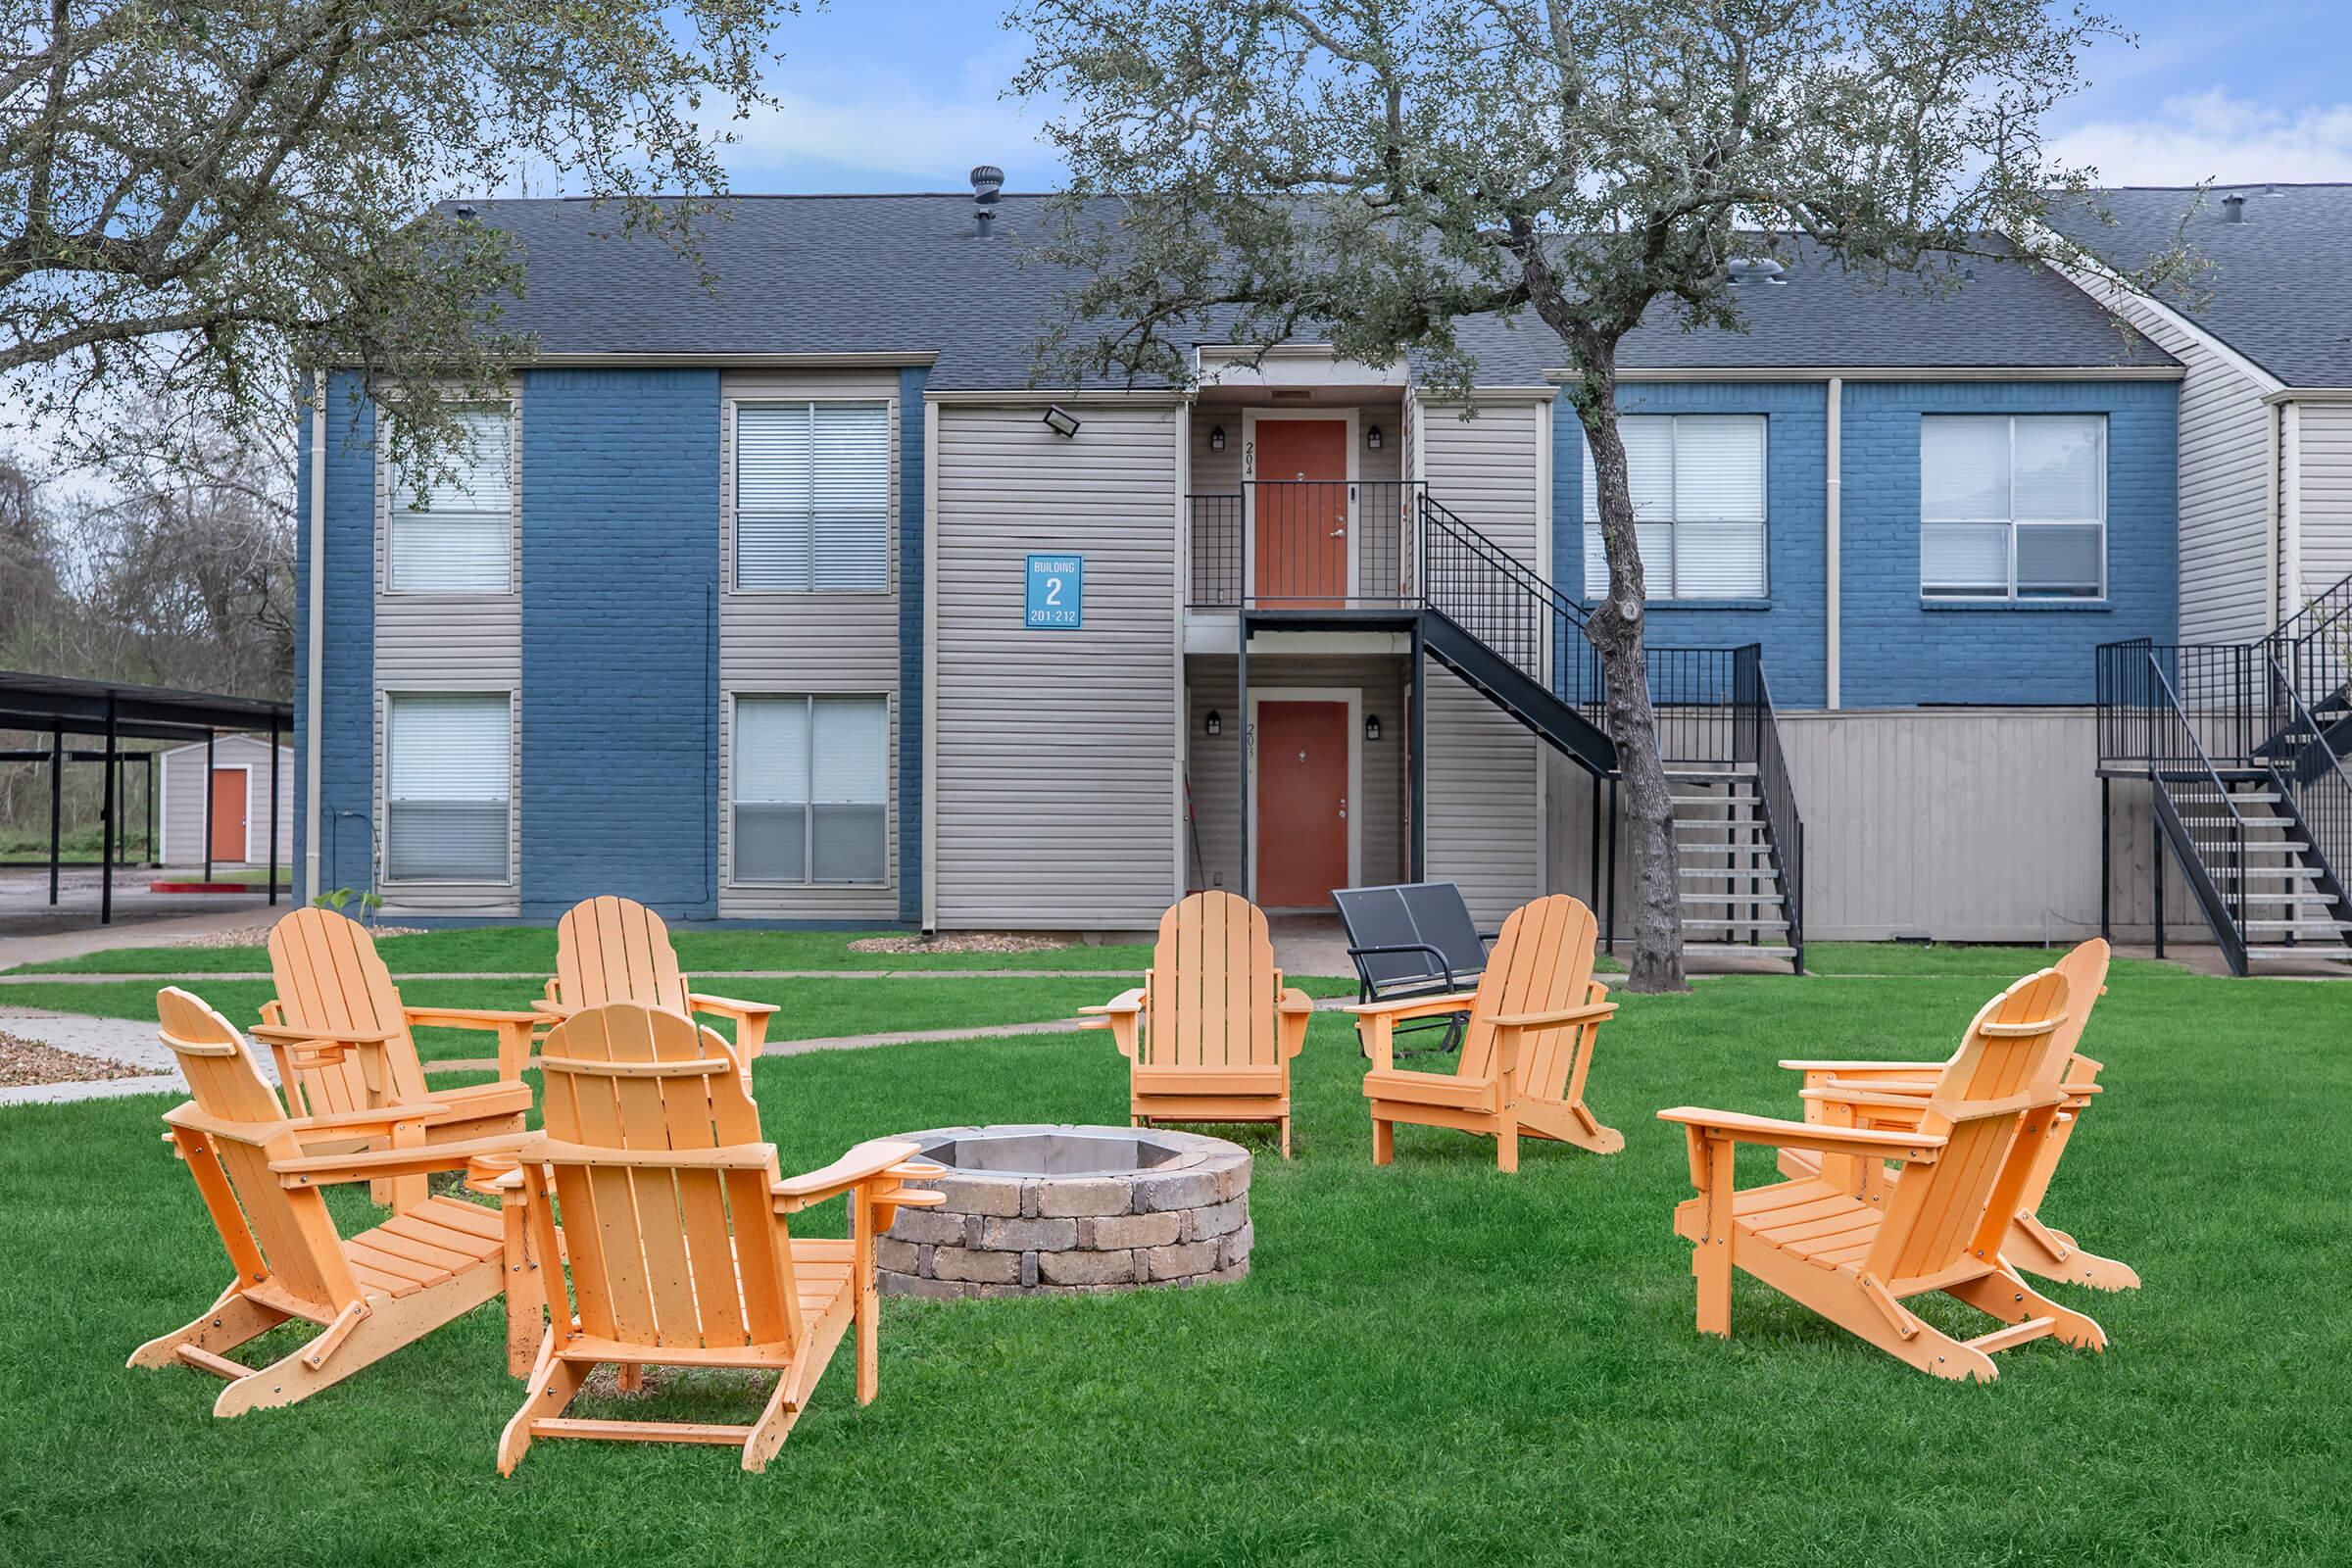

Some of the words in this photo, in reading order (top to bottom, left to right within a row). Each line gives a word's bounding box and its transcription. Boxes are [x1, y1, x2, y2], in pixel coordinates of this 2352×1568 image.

[1034, 562, 1075, 573] BUILDING
[1046, 577, 1062, 606] 2
[1031, 610, 1076, 622] 201-212
